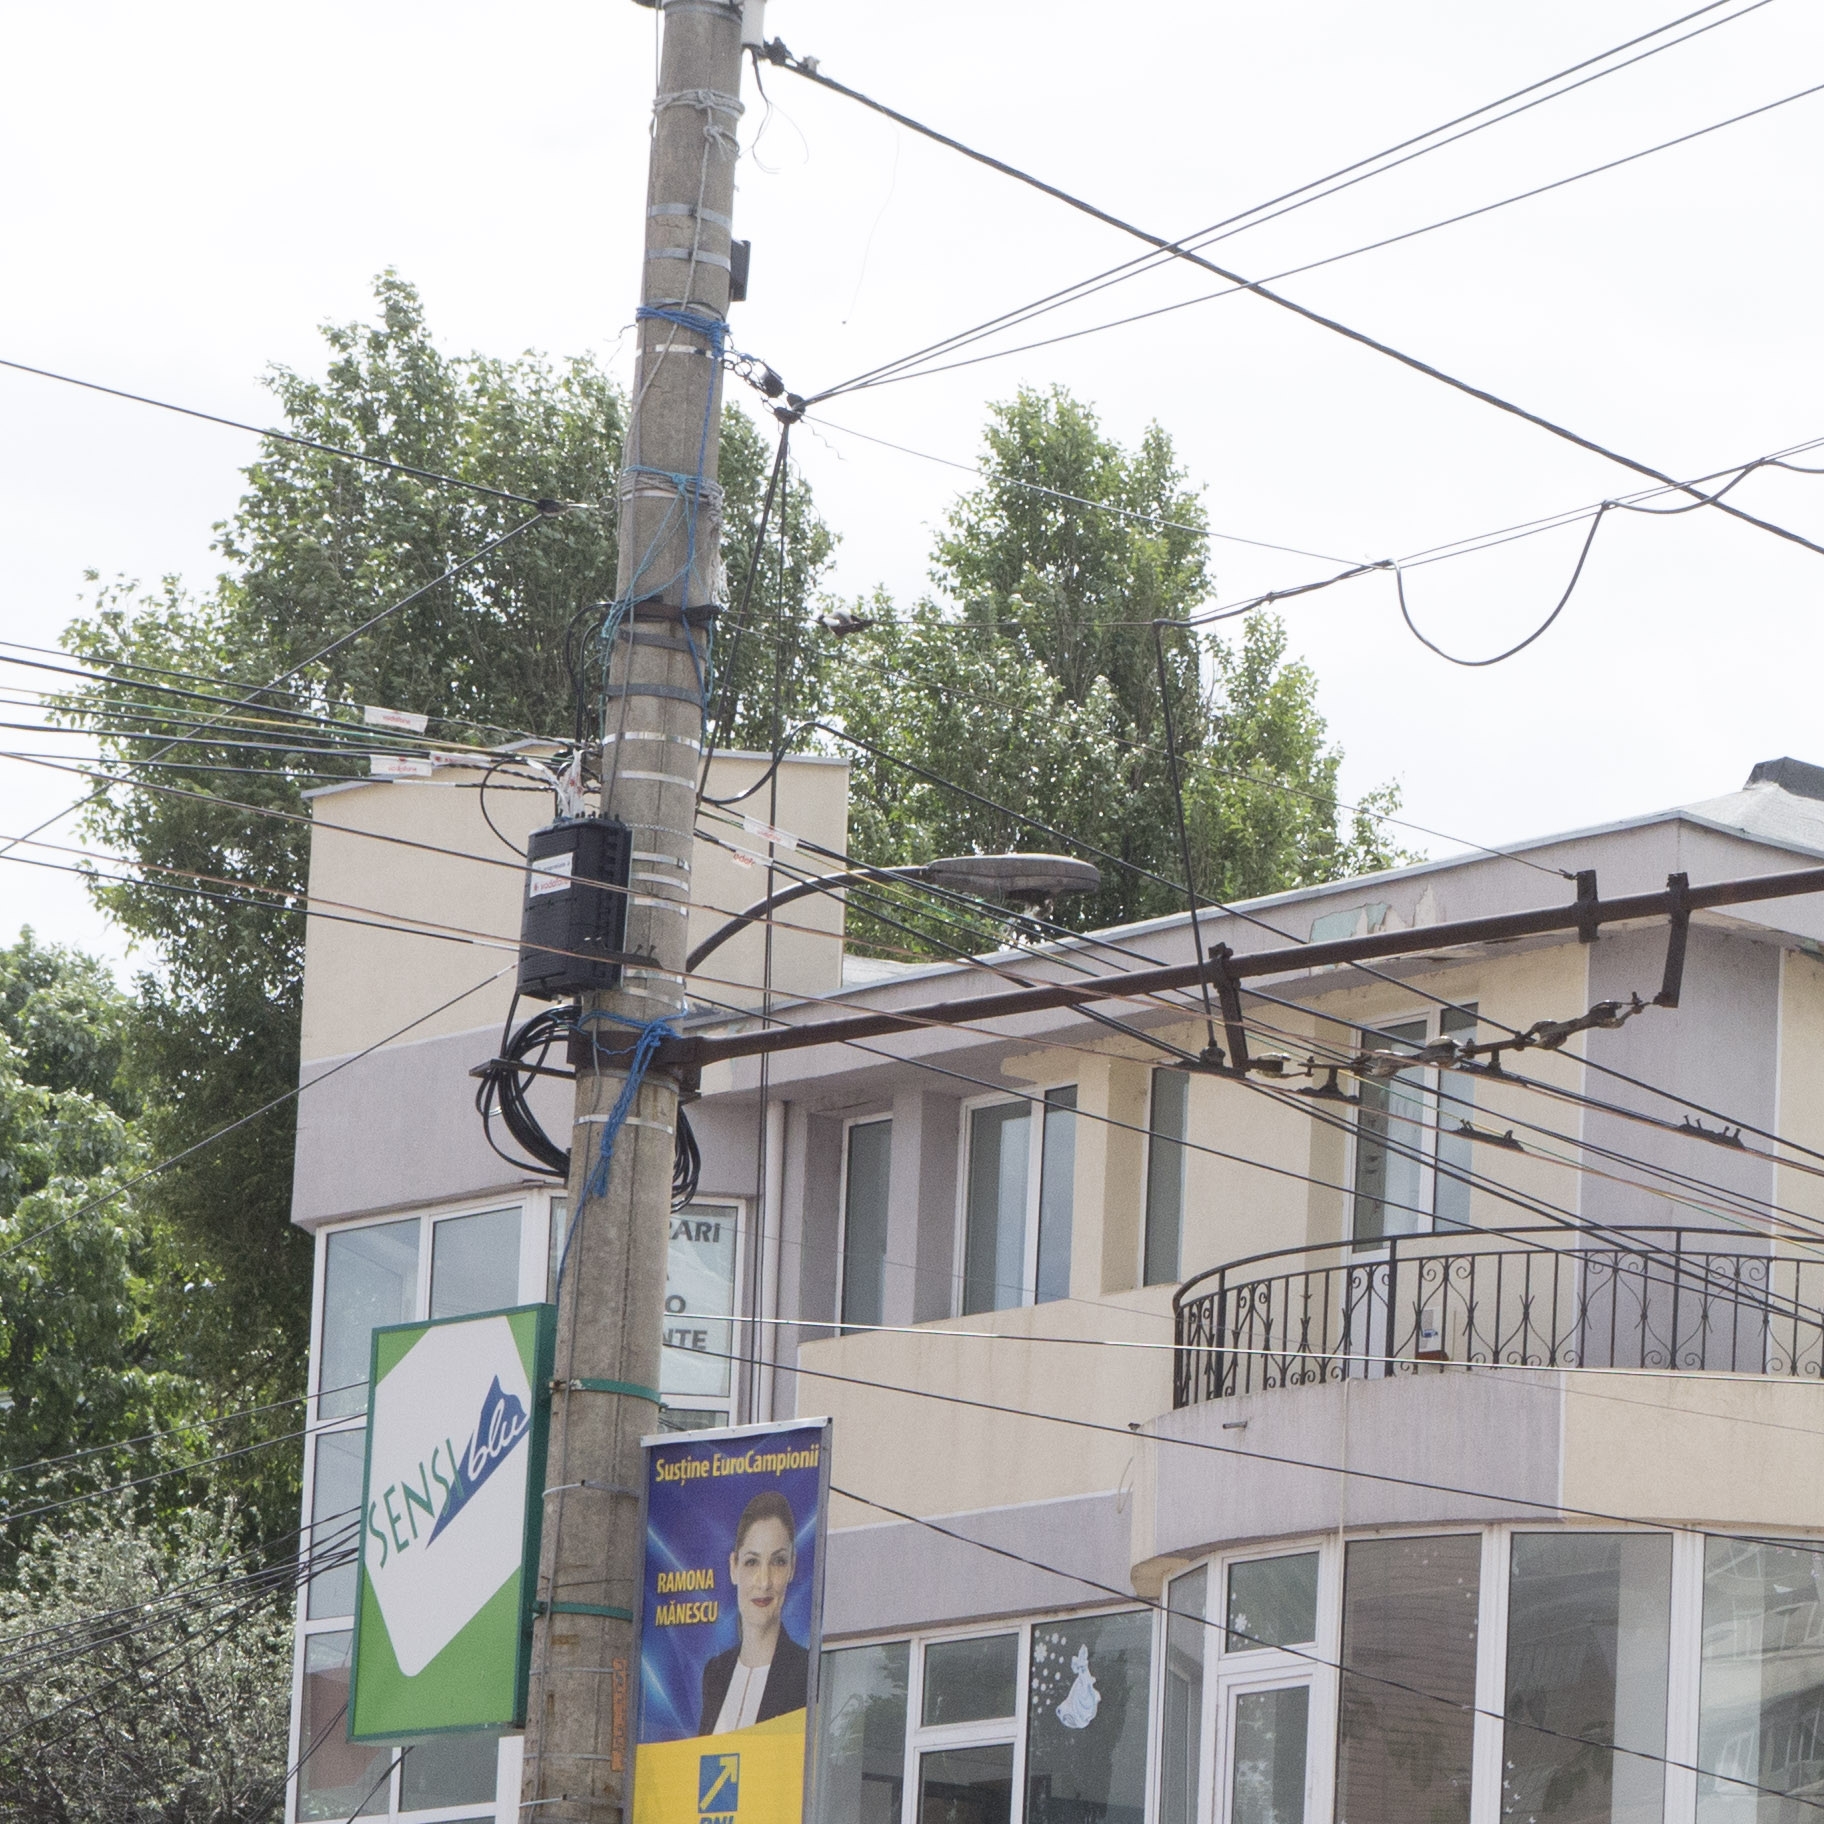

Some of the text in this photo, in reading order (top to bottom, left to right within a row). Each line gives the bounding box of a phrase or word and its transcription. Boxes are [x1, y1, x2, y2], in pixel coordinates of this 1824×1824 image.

[712, 1444, 820, 1477] EuroCampionii
[368, 1398, 530, 1570] SENSI blu
[657, 1569, 715, 1594] RAMONA
[655, 1600, 718, 1627] MĂNESCU
